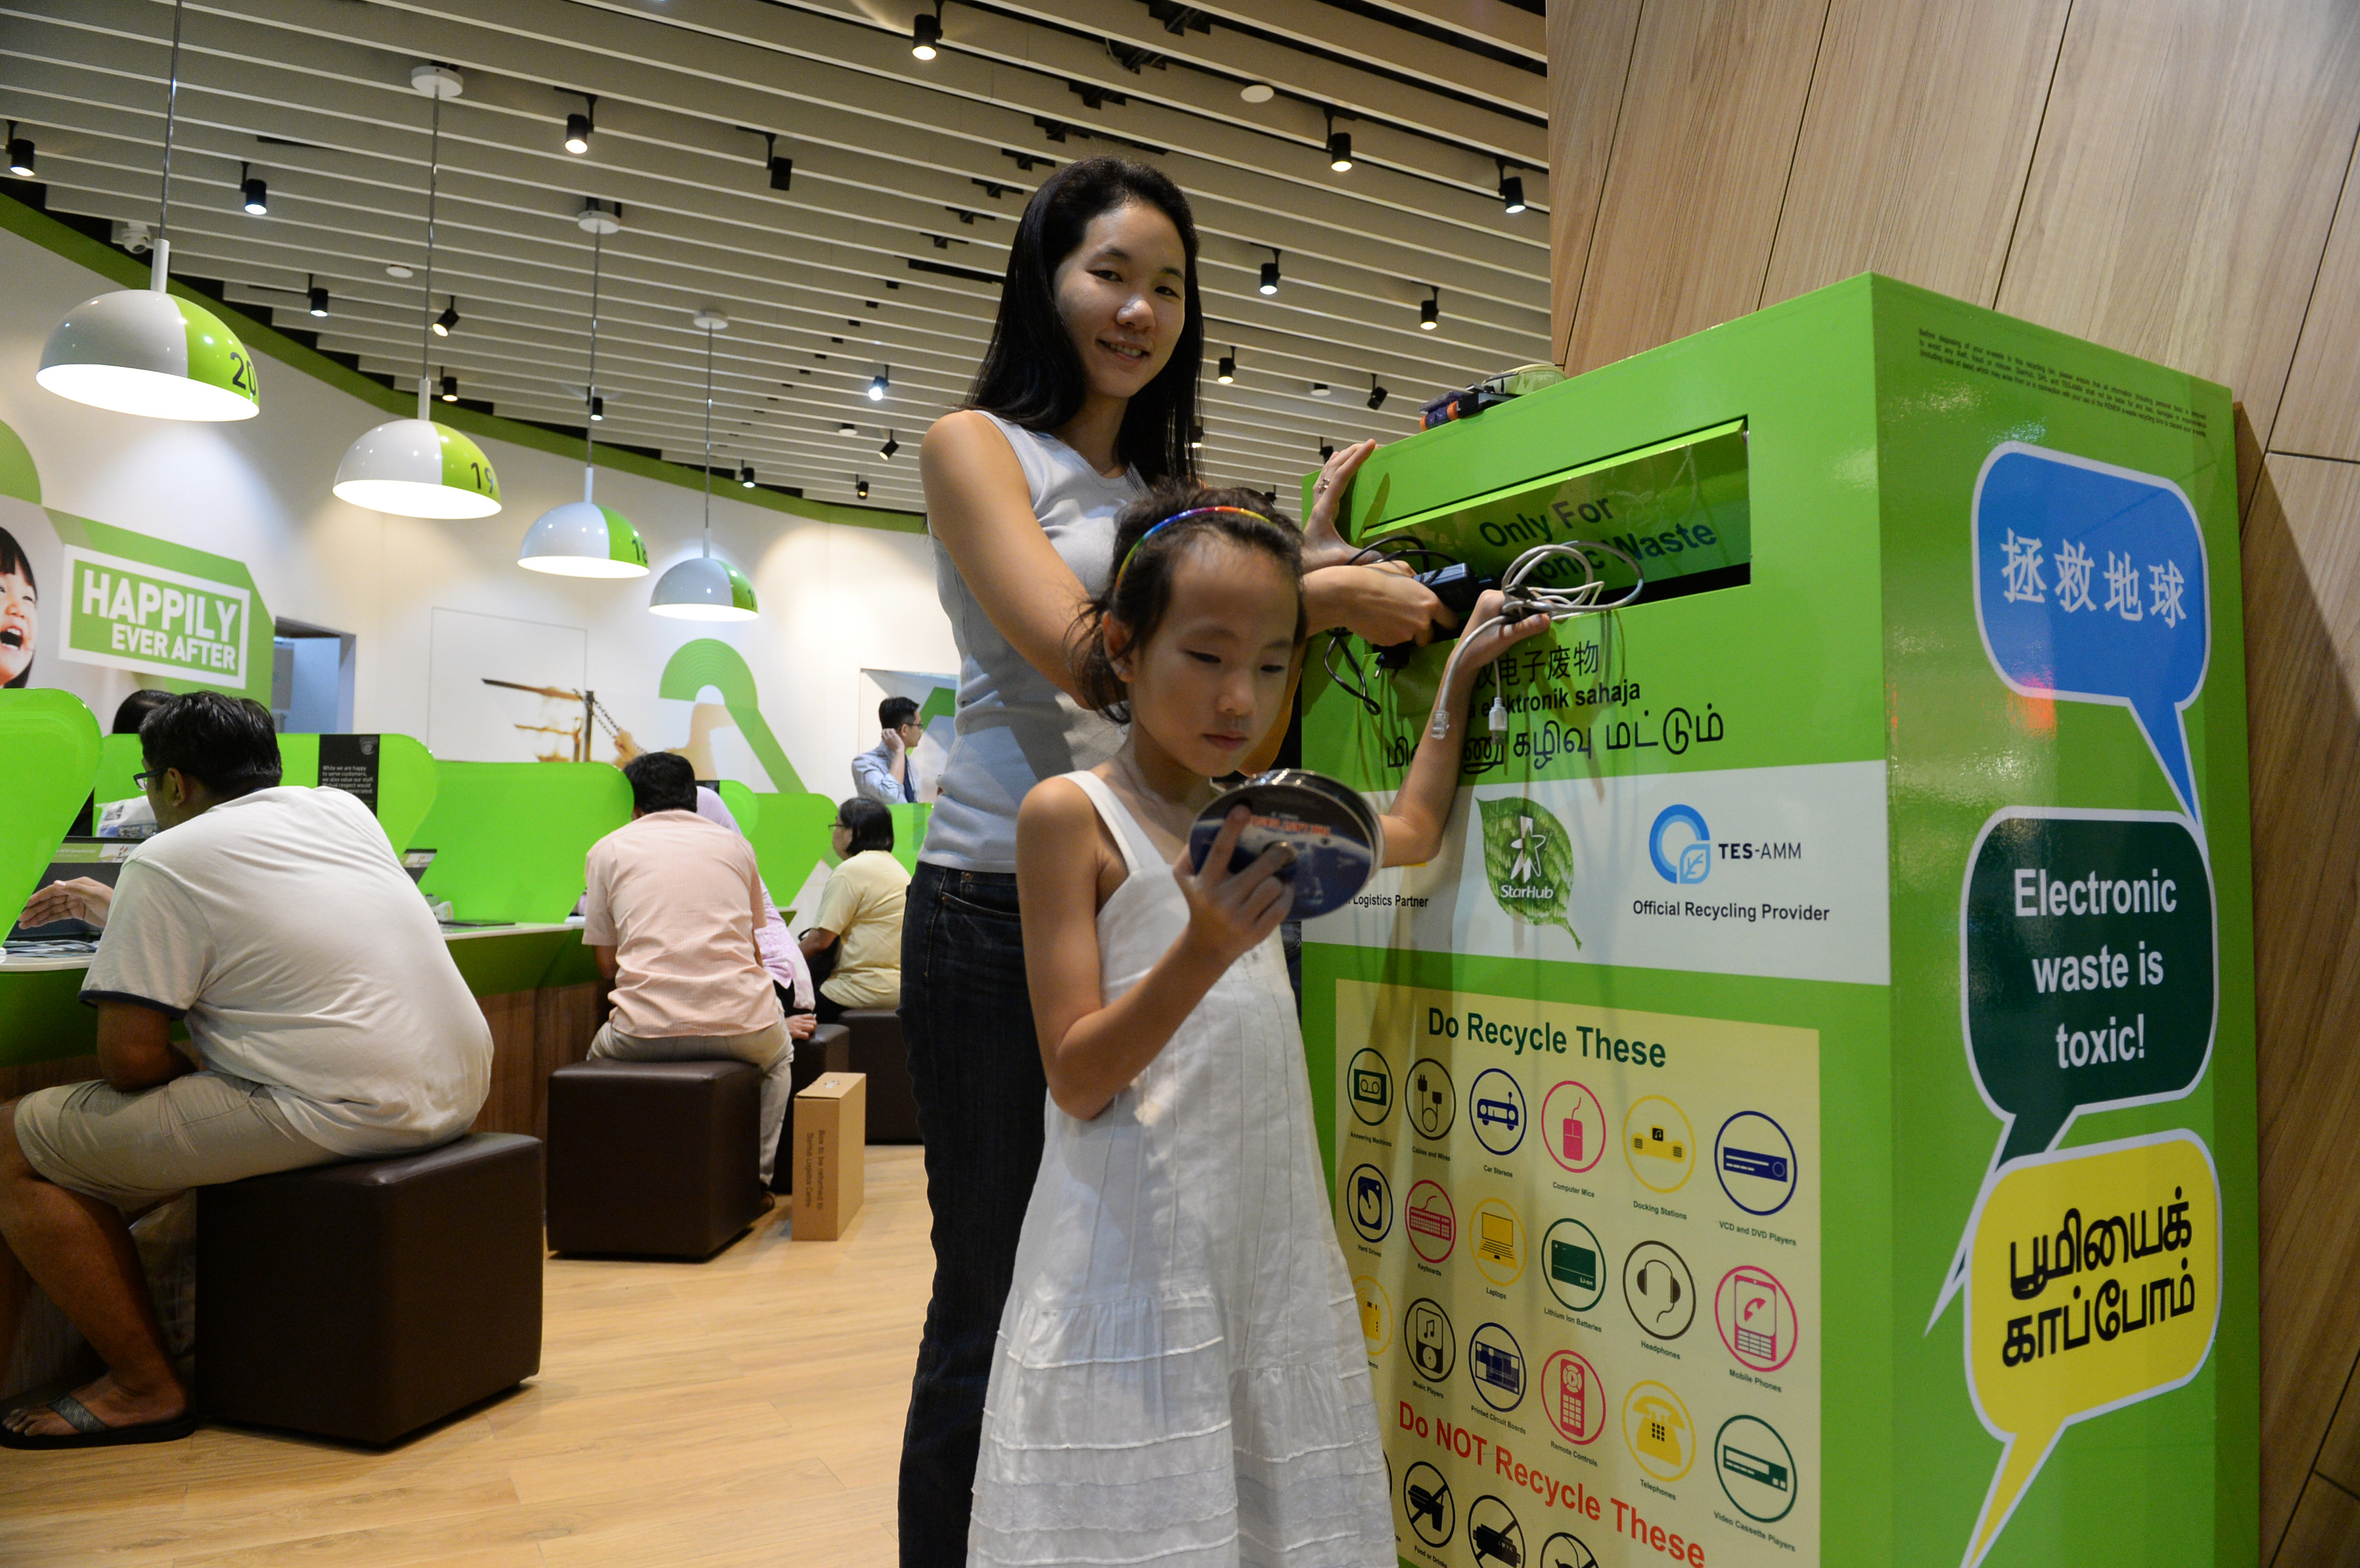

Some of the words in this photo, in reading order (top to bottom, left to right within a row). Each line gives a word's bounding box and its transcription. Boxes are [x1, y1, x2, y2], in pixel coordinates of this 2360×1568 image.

[229, 351, 257, 395] 20
[470, 462, 494, 494] 19
[1479, 513, 1551, 548] Only
[1552, 497, 1613, 530] For
[1609, 519, 1717, 562] Waste
[2000, 527, 2187, 628] 拯救地球
[82, 569, 238, 643] HAPPILY
[112, 623, 167, 659] EVER
[170, 633, 236, 670] AFTER
[1575, 679, 1640, 711] sahaja
[1606, 703, 1723, 755] மட்டும்
[1718, 842, 1801, 859] TES-AMM
[1354, 894, 1392, 908] Logistics
[1395, 894, 1429, 908] Partner
[1500, 884, 1554, 900] StarHub
[2015, 868, 2177, 917] Electronic
[1633, 900, 1680, 916] Official
[1685, 901, 1756, 923] Recycling
[1762, 903, 1830, 921] Provider
[2032, 944, 2129, 994] waste
[2138, 940, 2164, 986] is
[1428, 1007, 1460, 1039] Do
[1467, 1012, 1568, 1057] Recycle
[1577, 1025, 1667, 1069] These
[2056, 1013, 2145, 1069] toxic!
[1412, 1146, 1427, 1156] Cables
[1428, 1150, 1437, 1159] and
[1438, 1152, 1451, 1162] Wires
[1483, 1165, 1494, 1174] Car
[1494, 1167, 1513, 1178] Stereos
[1552, 1182, 1580, 1195] Computer
[1581, 1187, 1595, 1198] Mice
[1633, 1200, 1659, 1214] Docking
[1660, 1207, 1687, 1220] Stations
[1720, 1221, 1734, 1231] VCD
[1736, 1225, 1750, 1235] and
[1751, 1228, 1767, 1239] DVD
[1769, 1233, 1796, 1246] Players
[2010, 1186, 2192, 1300] பூமியைக்
[1358, 1244, 1368, 1254] Hard
[1368, 1247, 1382, 1258] Drives
[1417, 1263, 1442, 1277] Keyboards
[1486, 1286, 1506, 1300] Laptops
[1544, 1307, 1564, 1321] Lithium
[1565, 1314, 1575, 1323] Ion
[1576, 1318, 1602, 1333] Batteries
[2002, 1257, 2195, 1368] காப்போம்
[1640, 1340, 1681, 1360] Headphones
[1412, 1380, 1426, 1391] Music
[1427, 1386, 1444, 1399] Players
[1729, 1369, 1753, 1383] Mobile
[1755, 1376, 1782, 1392] Phones
[1471, 1405, 1488, 1419] Printed
[1489, 1413, 1506, 1426] Circuit
[1506, 1421, 1525, 1435] Boards
[1550, 1440, 1571, 1456] Remote
[1573, 1451, 1598, 1467] Controls
[1399, 1400, 1428, 1438] Do
[1436, 1417, 1486, 1466] NOT
[1495, 1445, 1601, 1521] Recycle
[1610, 1497, 1706, 1568] These
[1640, 1479, 1676, 1500] Telephones
[1714, 1511, 1734, 1526] Video
[1736, 1520, 1766, 1540] Cassette
[1768, 1534, 1796, 1552] Players
[1414, 1545, 1426, 1557] Food
[1433, 1555, 1448, 1568] Drinks
